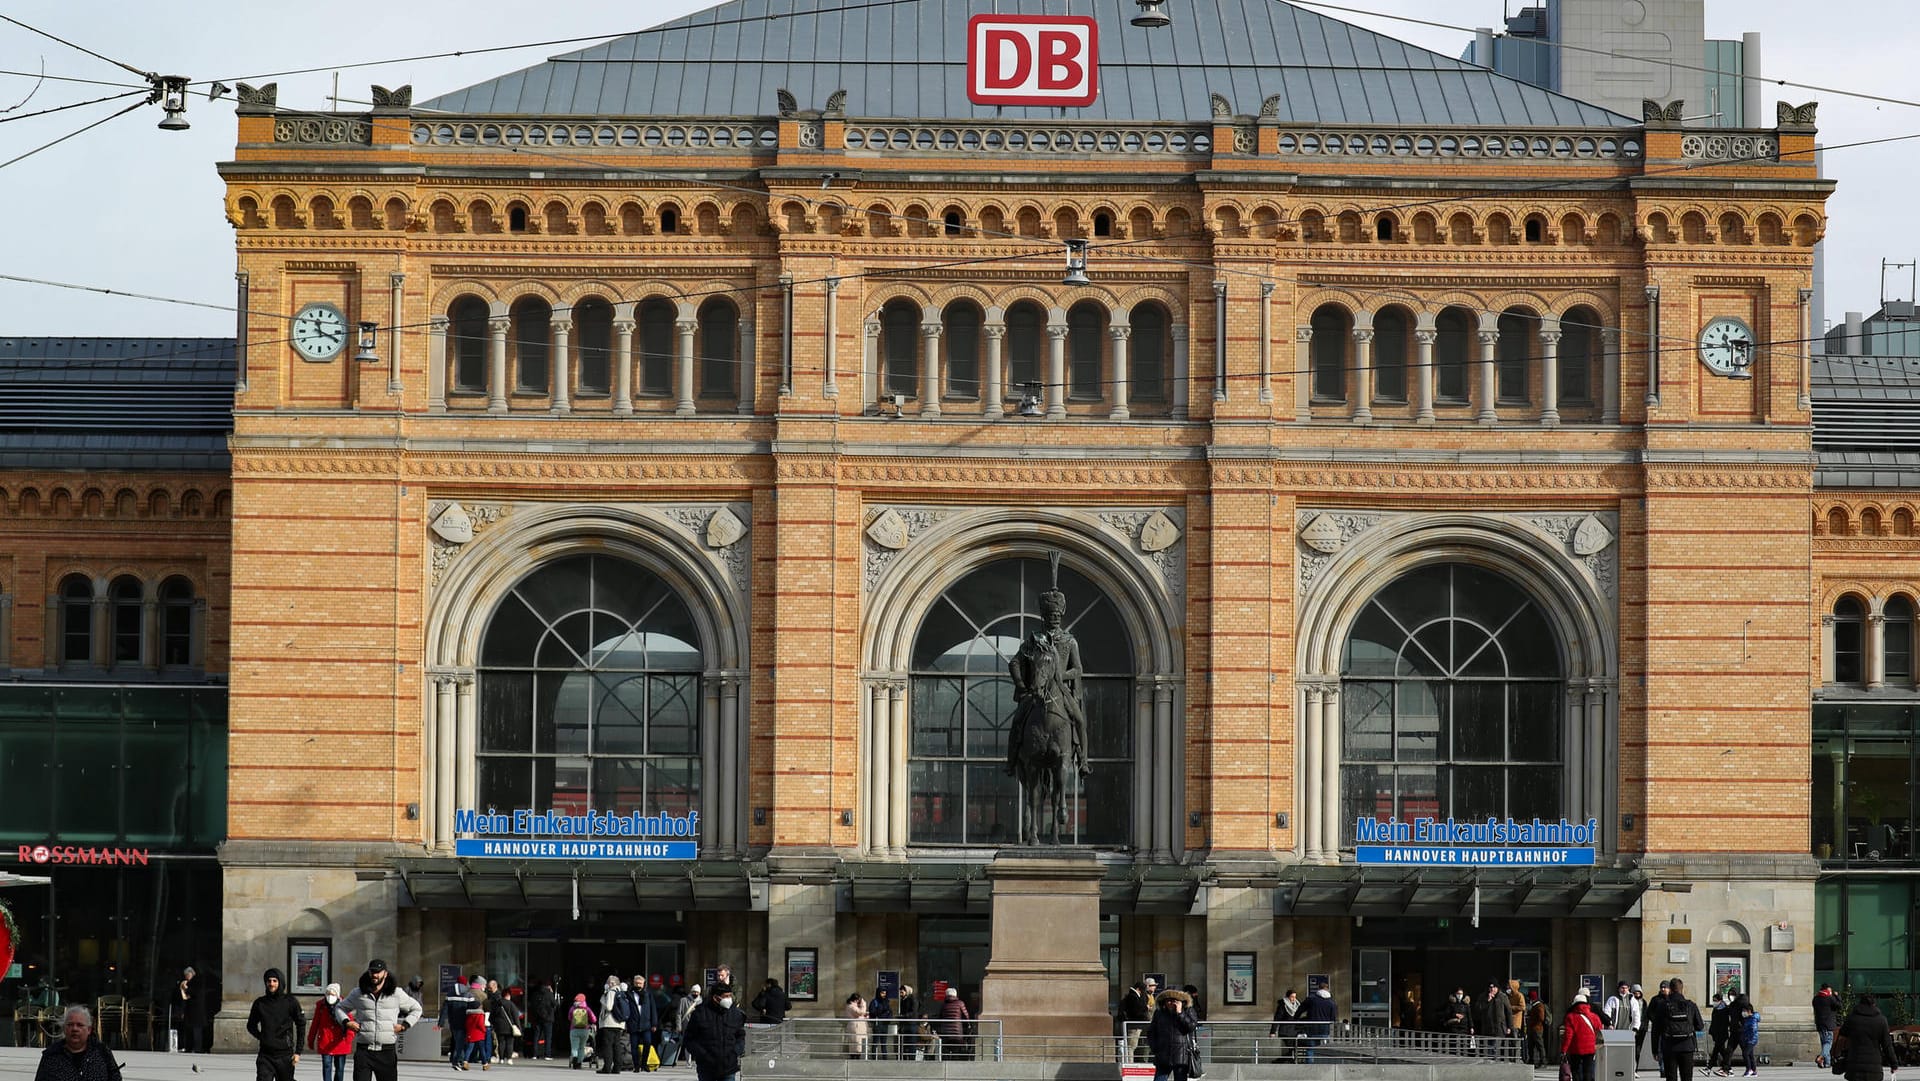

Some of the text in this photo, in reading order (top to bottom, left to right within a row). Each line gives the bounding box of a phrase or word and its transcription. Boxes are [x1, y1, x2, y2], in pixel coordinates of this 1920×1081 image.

[985, 29, 1084, 90] DB
[455, 808, 698, 837] Mein Einkaufsbahnhof
[1356, 816, 1597, 844] Mein Einkaufsbahnhof
[18, 845, 149, 866] ROSSMANN
[484, 842, 670, 857] HANNOVER HAUPTBAHNHOF
[1384, 849, 1569, 863] HANNOVER HAUPTBAHNHOF
